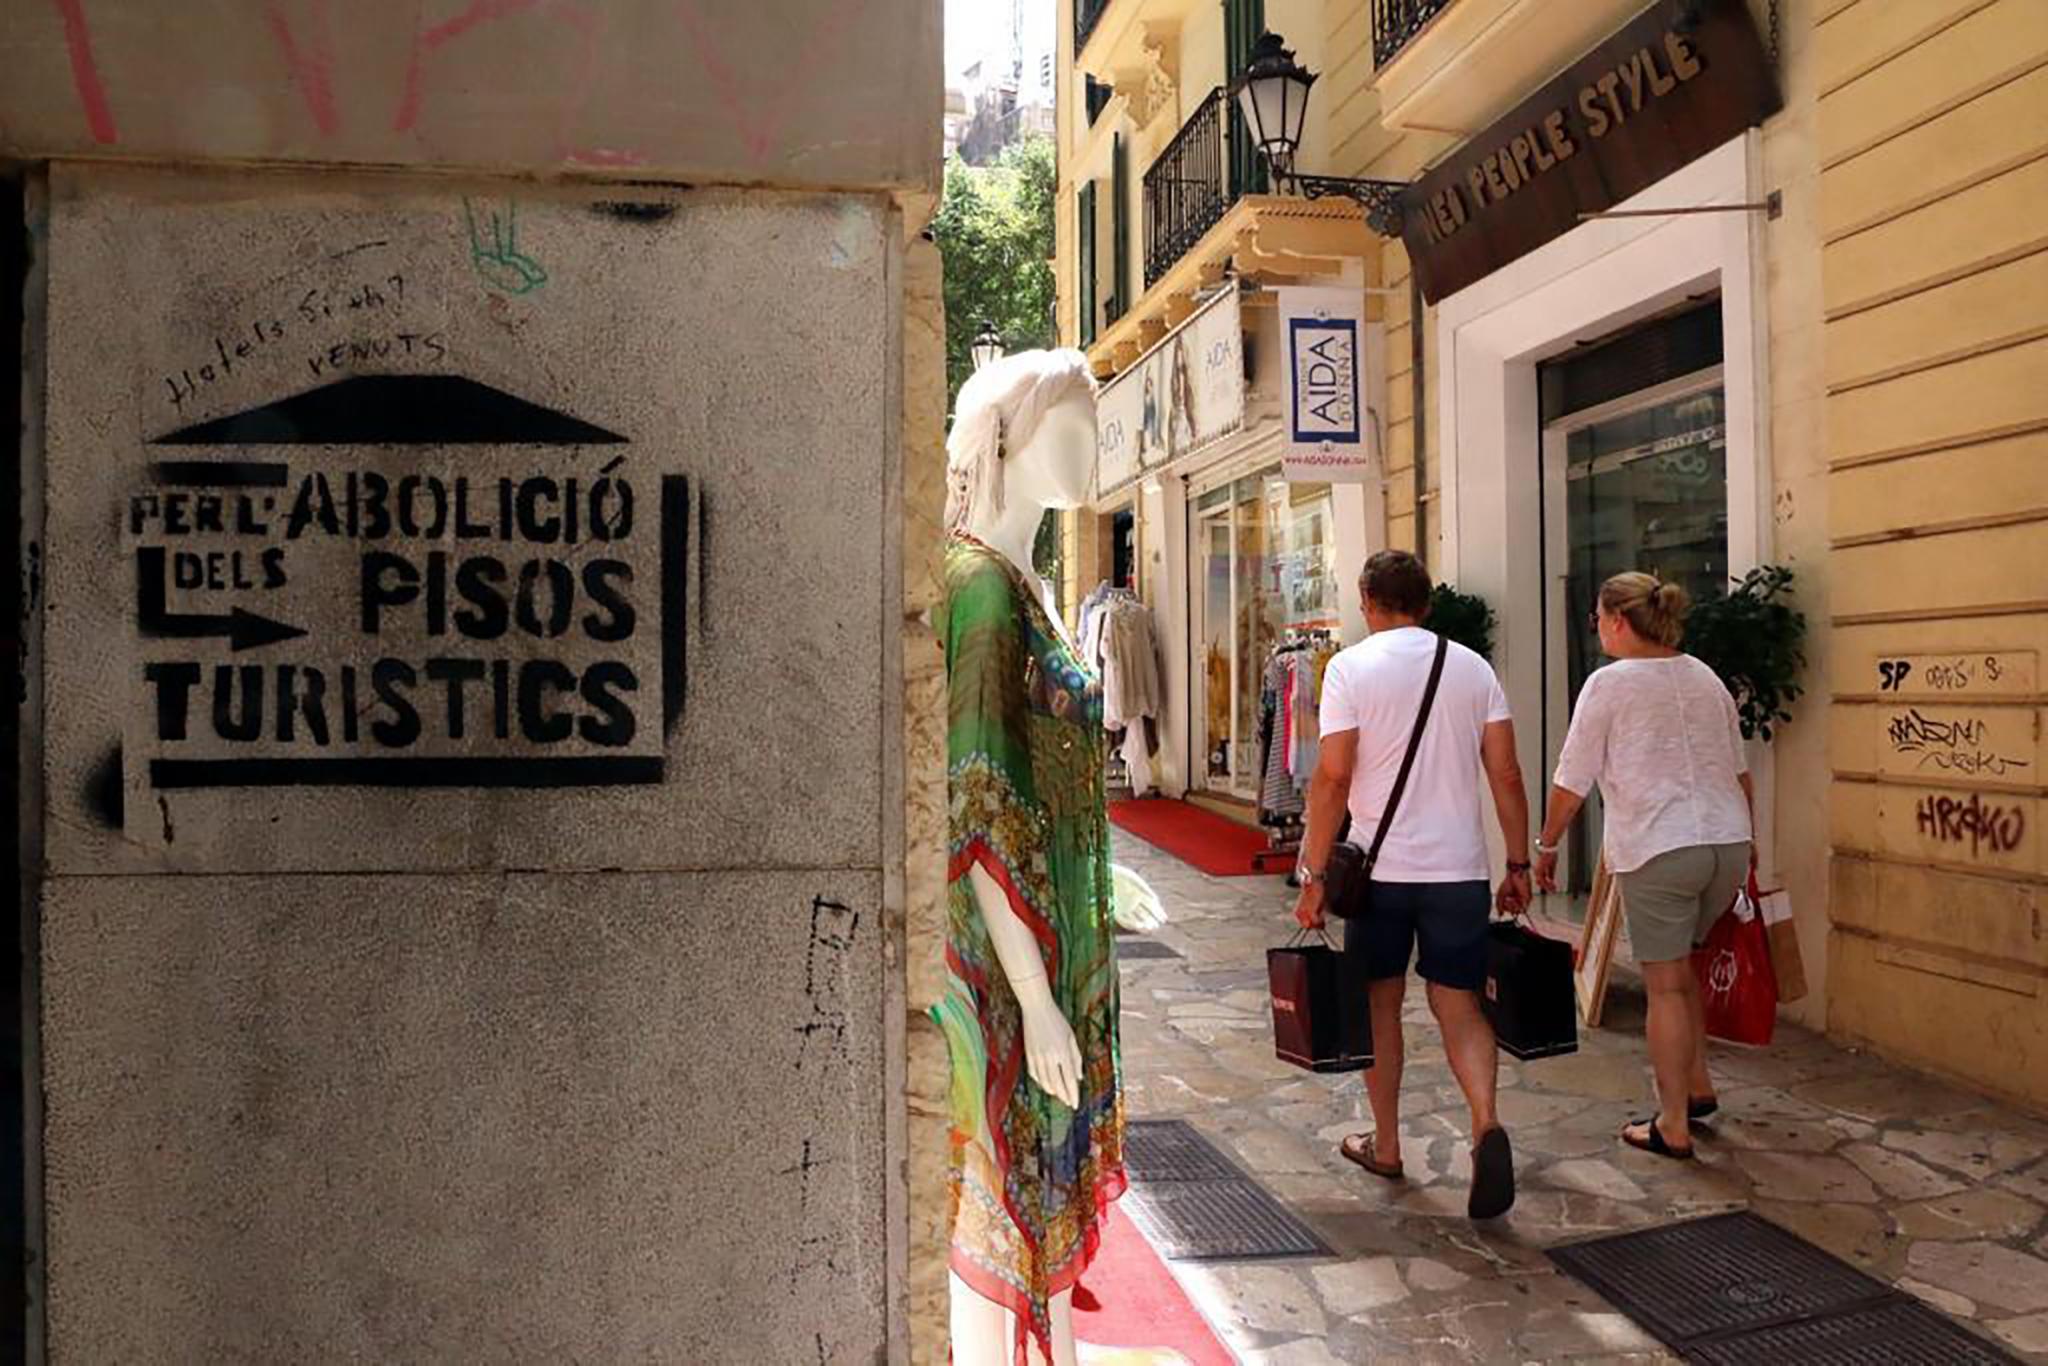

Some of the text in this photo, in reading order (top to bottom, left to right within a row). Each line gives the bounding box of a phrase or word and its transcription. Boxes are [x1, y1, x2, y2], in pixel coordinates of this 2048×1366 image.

[1469, 110, 1575, 209] PEOPLE
[1578, 31, 1700, 138] STYLE
[1308, 336, 1339, 425] AIDA
[130, 494, 224, 534] PER
[174, 547, 637, 641] DELS PISOS
[144, 658, 638, 747] TURISTICS
[1879, 660, 1911, 691] SP
